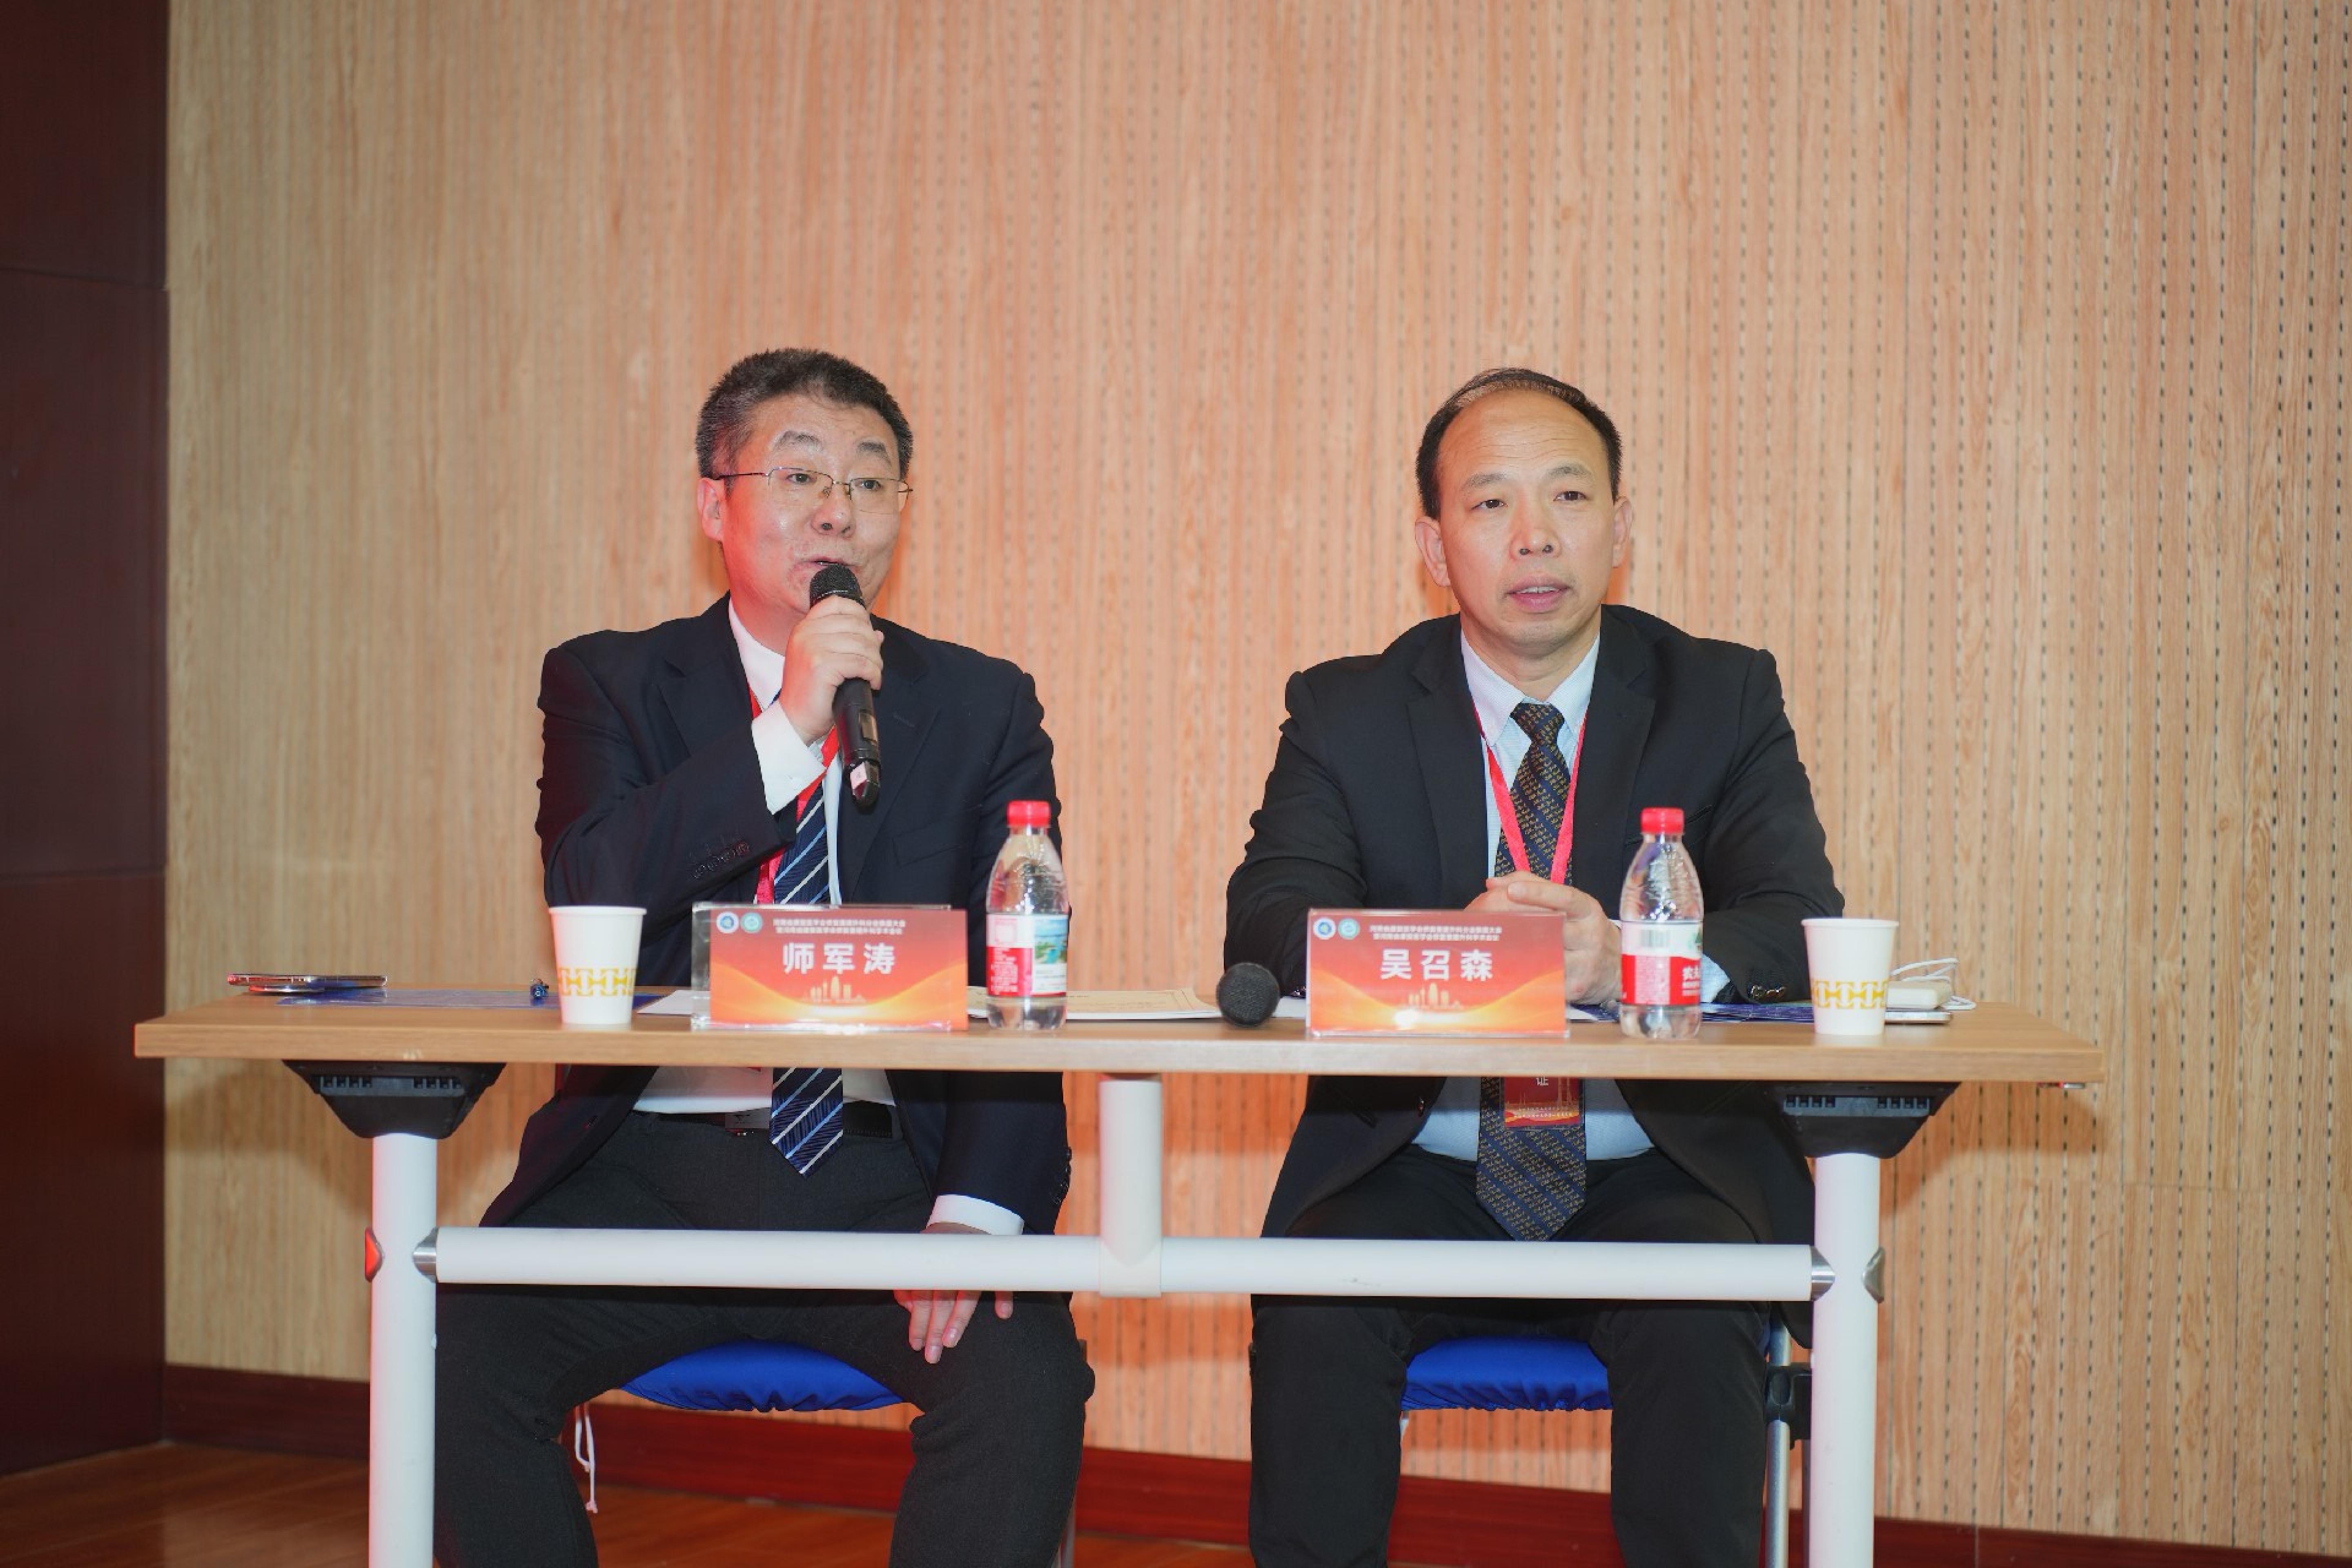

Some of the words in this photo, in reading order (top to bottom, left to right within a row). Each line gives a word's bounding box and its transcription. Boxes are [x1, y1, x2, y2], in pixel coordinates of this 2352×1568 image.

[782, 942, 895, 974] 师军涛
[1380, 949, 1493, 982] 吴召森
